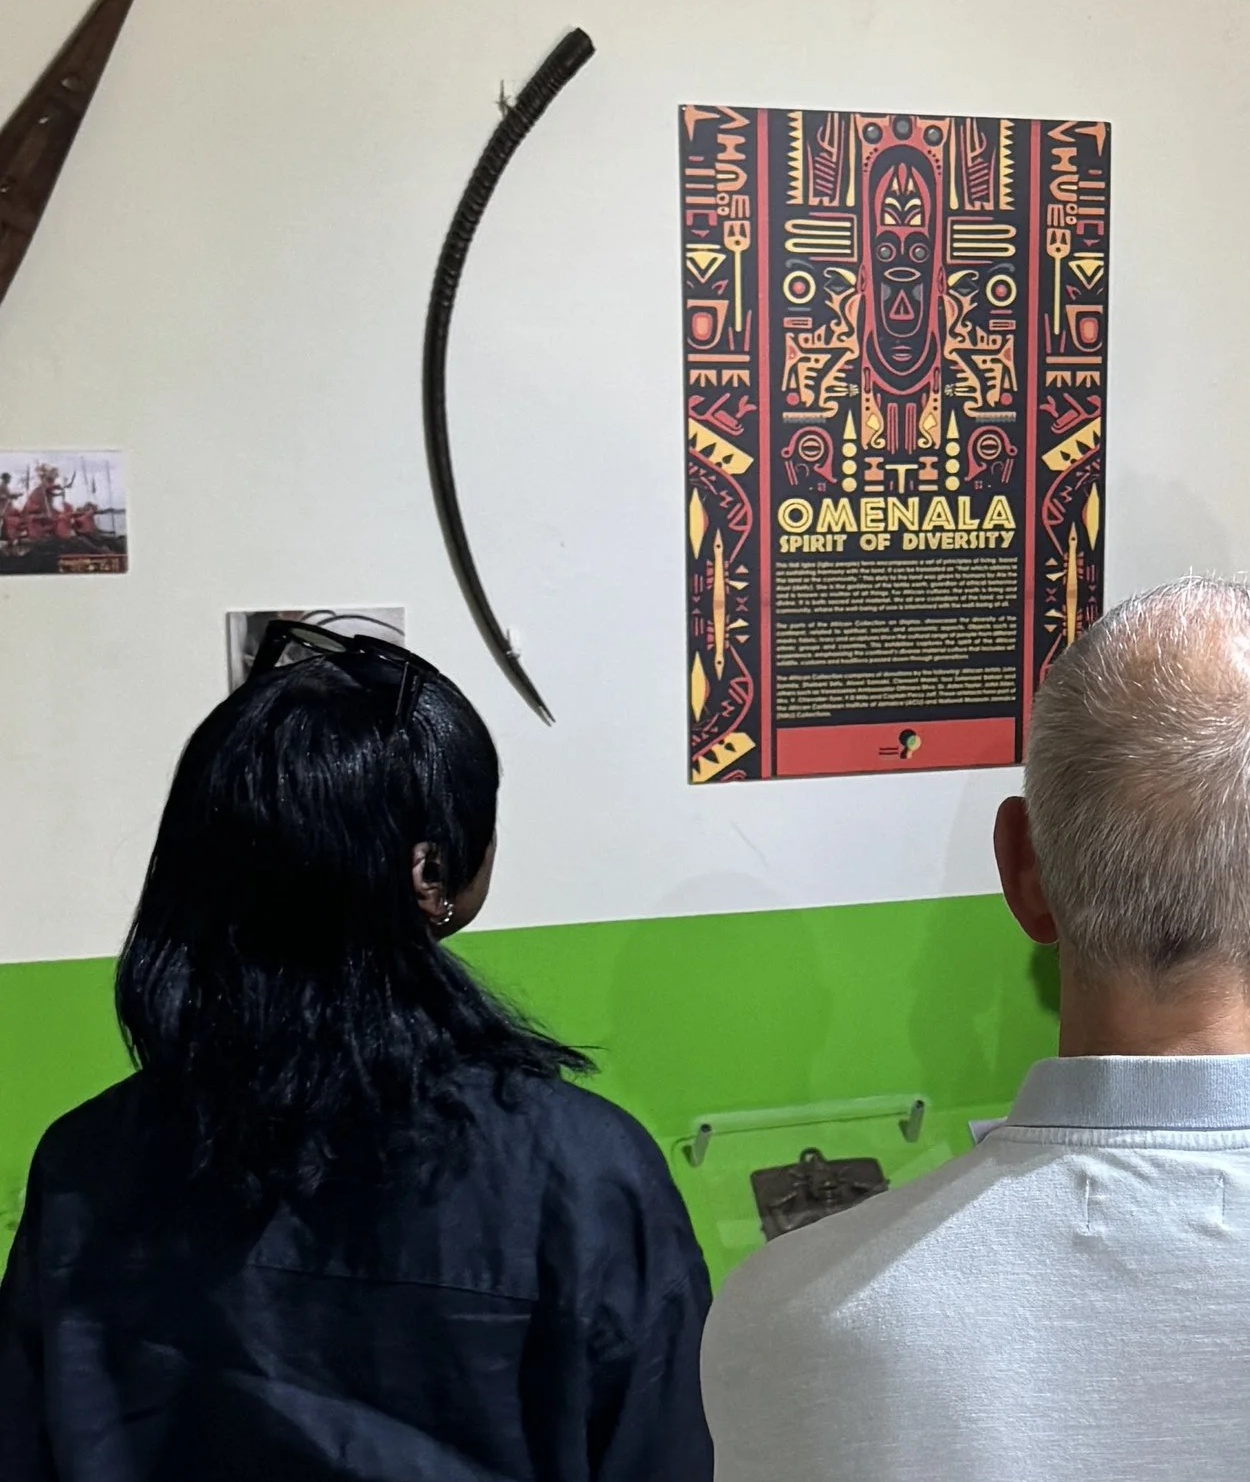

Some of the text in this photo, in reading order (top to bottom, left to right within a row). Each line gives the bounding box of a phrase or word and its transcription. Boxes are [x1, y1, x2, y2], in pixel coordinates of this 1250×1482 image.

[777, 495, 1017, 534] OMENALA
[779, 530, 1015, 553] SPIRIT OF DIVERSITY
